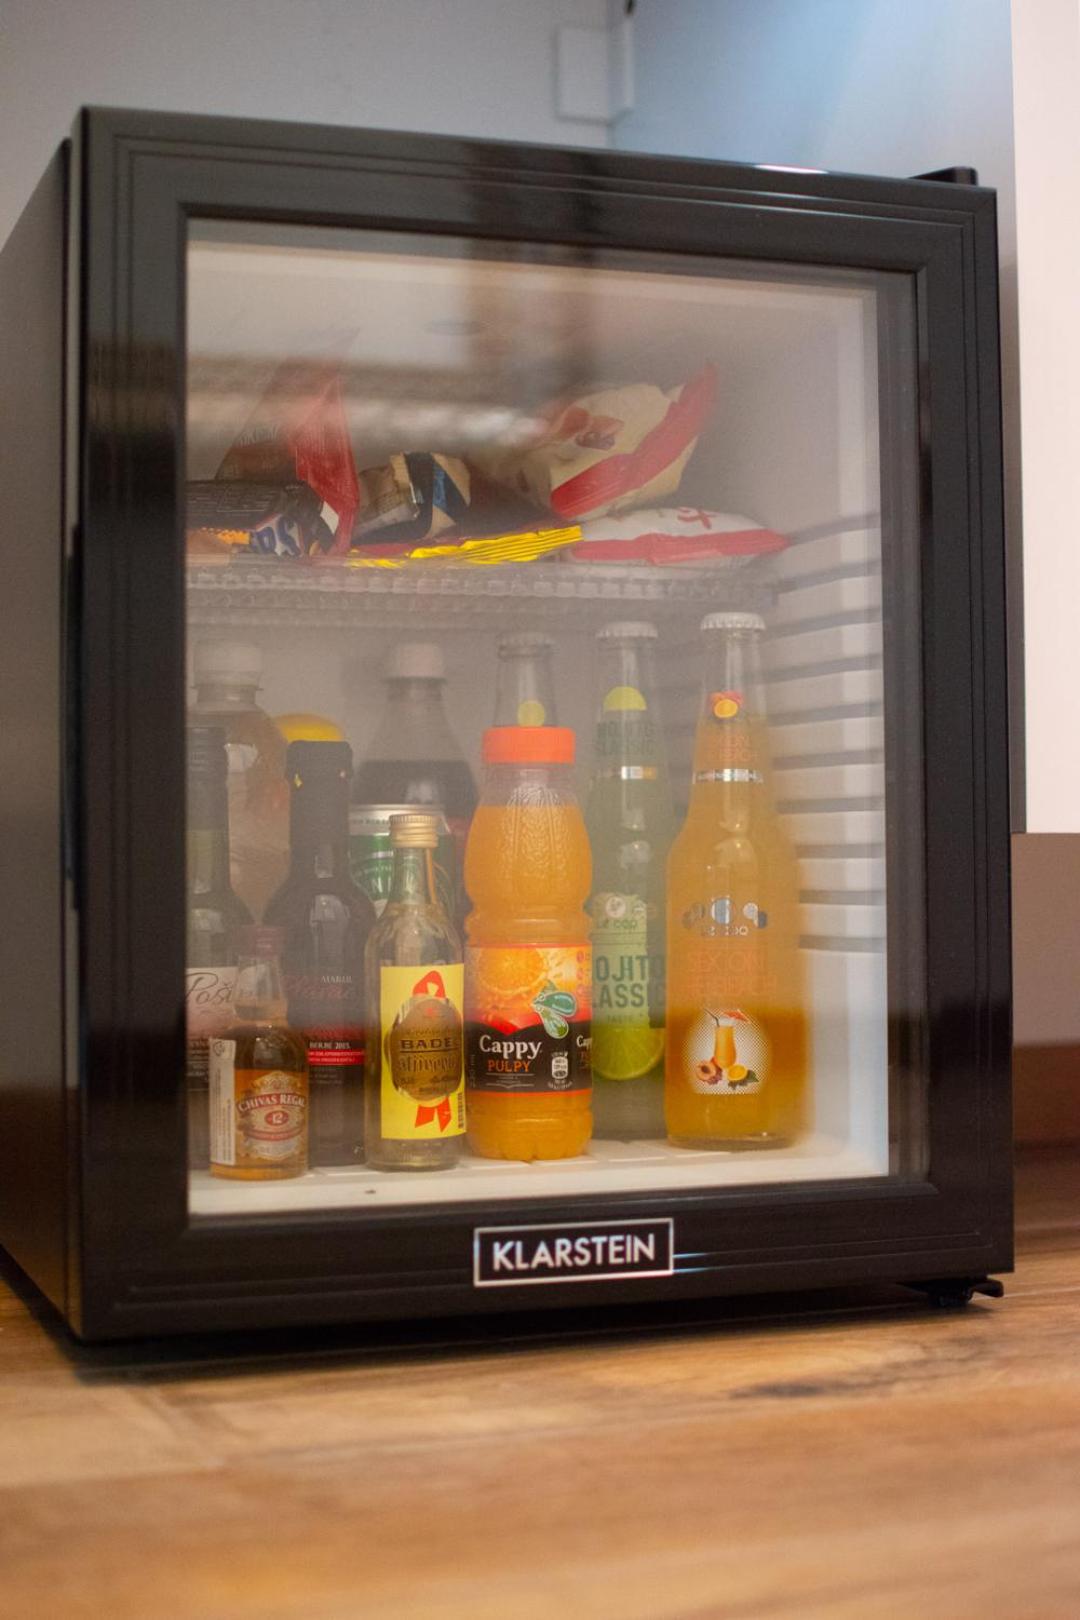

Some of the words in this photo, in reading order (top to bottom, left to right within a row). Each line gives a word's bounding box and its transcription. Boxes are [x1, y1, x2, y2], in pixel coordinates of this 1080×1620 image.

[478, 1034, 543, 1060] Cappy
[487, 1058, 531, 1073] PULPY
[237, 1094, 278, 1112] CHIVAS
[279, 1093, 306, 1108] REGAL
[492, 1233, 655, 1271] KLARSTEIN
